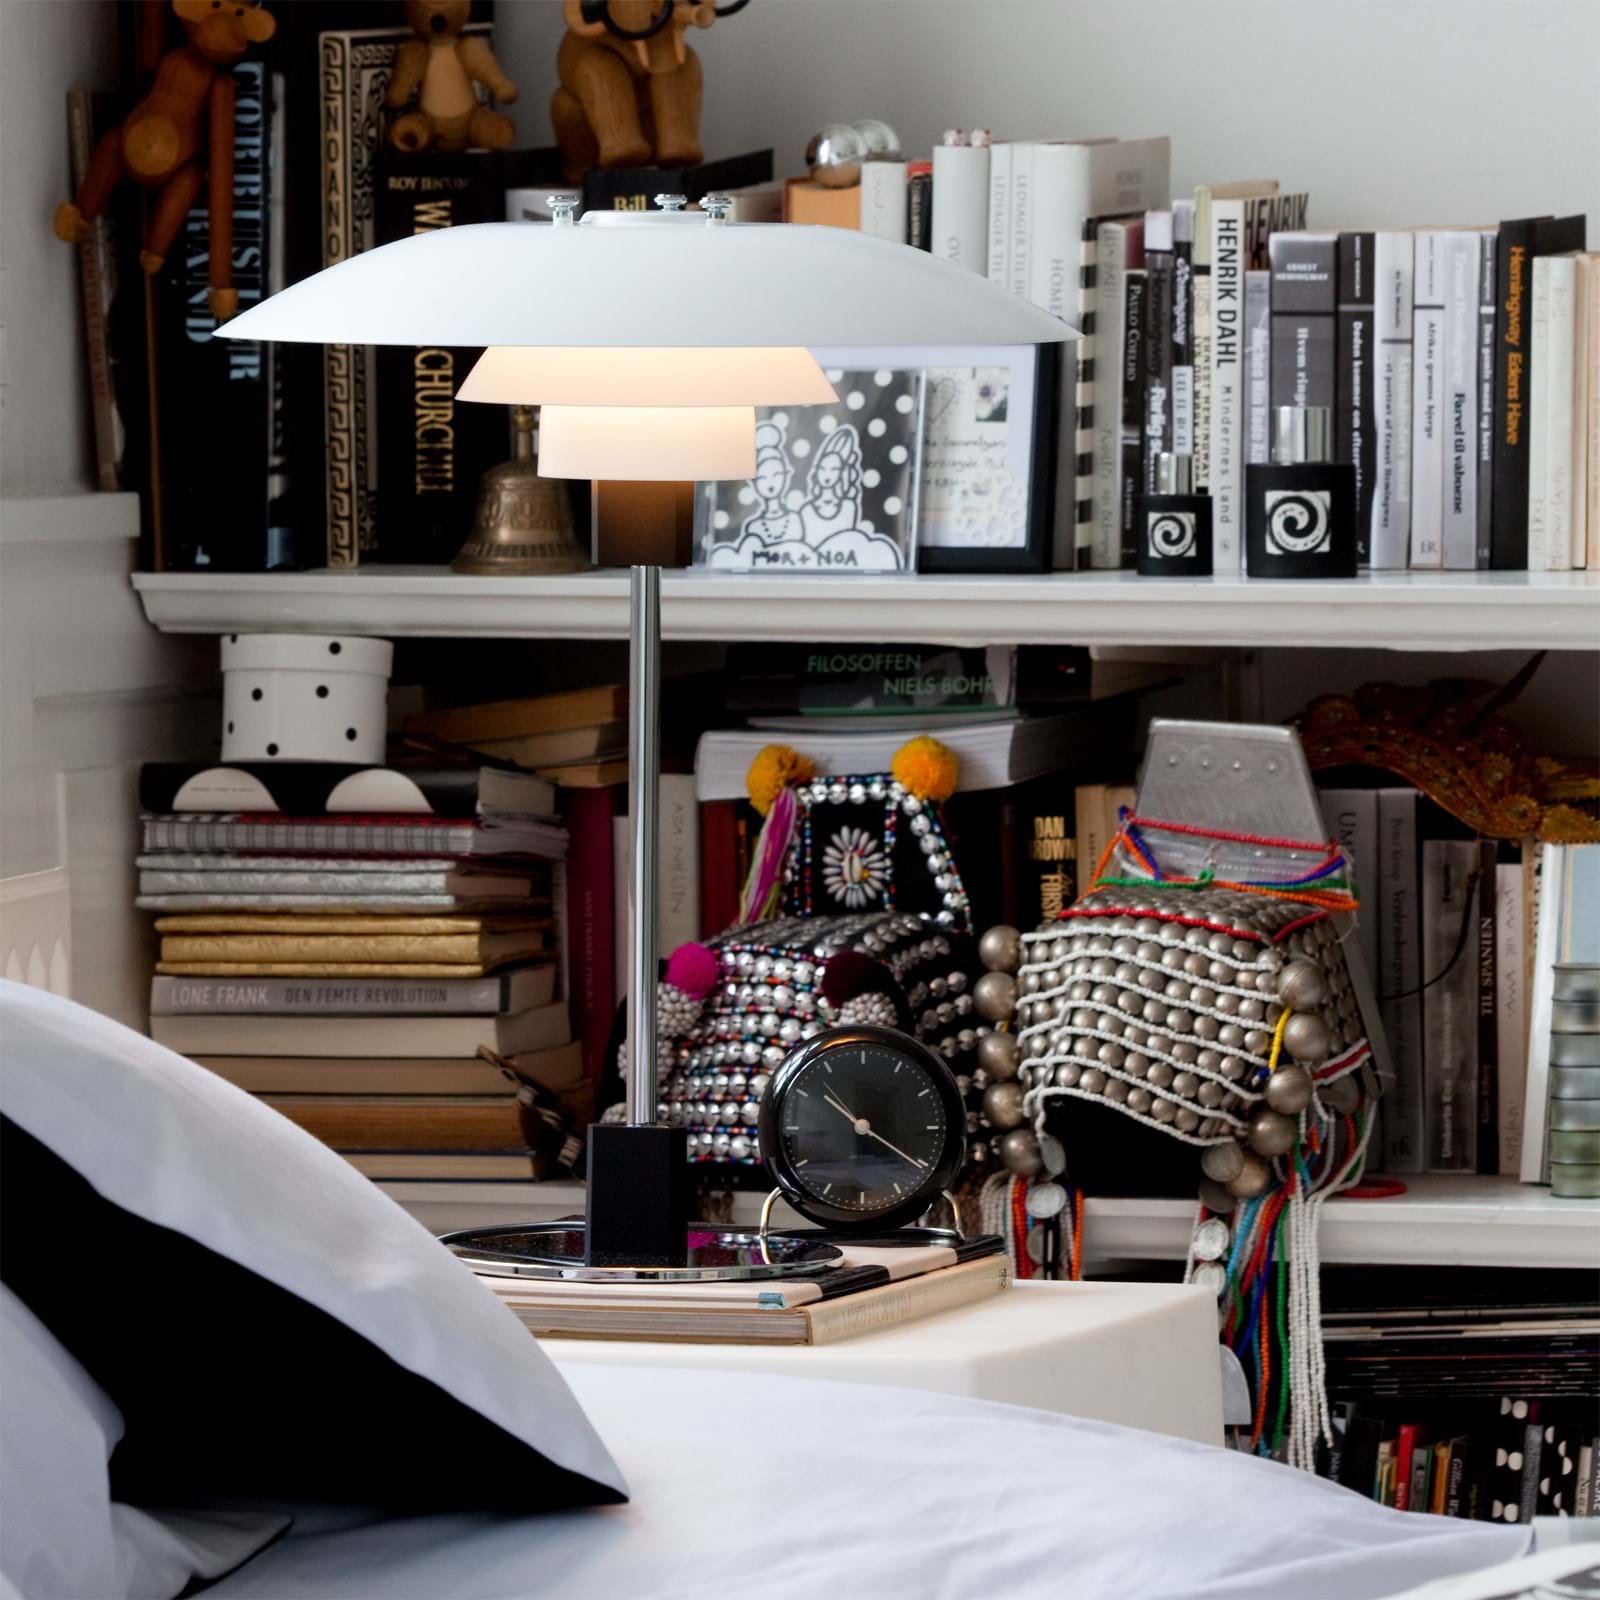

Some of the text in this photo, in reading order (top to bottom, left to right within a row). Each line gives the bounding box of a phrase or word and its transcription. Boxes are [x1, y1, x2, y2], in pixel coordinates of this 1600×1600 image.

[388, 176, 416, 190] ROY
[614, 195, 647, 210] Bill
[229, 62, 263, 381] CORBUSIR
[992, 175, 1007, 273] LEDSAGER TIL
[1014, 174, 1028, 247] LEDSAGER
[186, 208, 216, 343] RAND
[1014, 252, 1026, 273] TIL
[1217, 218, 1238, 302] HENRIK
[1275, 273, 1329, 281] HEMINGWAY
[1286, 263, 1318, 271] ERNEST
[1128, 285, 1141, 326] PAULO
[1173, 257, 1190, 346] Hemingway
[1149, 268, 1167, 379] Hemingway
[1217, 309, 1237, 369] DAHL
[1352, 321, 1363, 358] Døden
[1427, 322, 1436, 360] Afrikas
[1483, 324, 1492, 343] Den
[1126, 329, 1140, 382] COELHO
[1297, 327, 1309, 368] Hvem
[1450, 303, 1467, 386] Hemingway
[1505, 246, 1525, 446] Hemingway Edens Have
[1351, 361, 1363, 407] kommer
[1482, 383, 1491, 412] mand
[413, 350, 454, 495] CHURCHILL
[1147, 387, 1166, 436] Farlig
[1202, 336, 1211, 480] ERNEST HEMINGWAY
[1352, 410, 1360, 429] om
[1424, 405, 1435, 439] bjerge
[1454, 393, 1466, 436] Farvel
[1481, 414, 1491, 428] og
[1221, 385, 1232, 476] Mindernes
[1384, 433, 1393, 466] Ernest
[1454, 439, 1465, 453] til
[1481, 431, 1491, 462] havet
[1381, 468, 1392, 529] Hemingway
[817, 549, 858, 566] NOA
[808, 653, 921, 673] FILOSOFFEN
[883, 676, 936, 696] NIELS
[1034, 816, 1064, 838] DAN
[1028, 838, 1077, 861] ROWN
[1480, 916, 1493, 1017] TIL SPANIEN
[170, 985, 448, 1006] LONE FRANK DEN FEMTE REVOLUTION
[1441, 1079, 1453, 1102] Eco
[1441, 1104, 1453, 1158] Umberto
